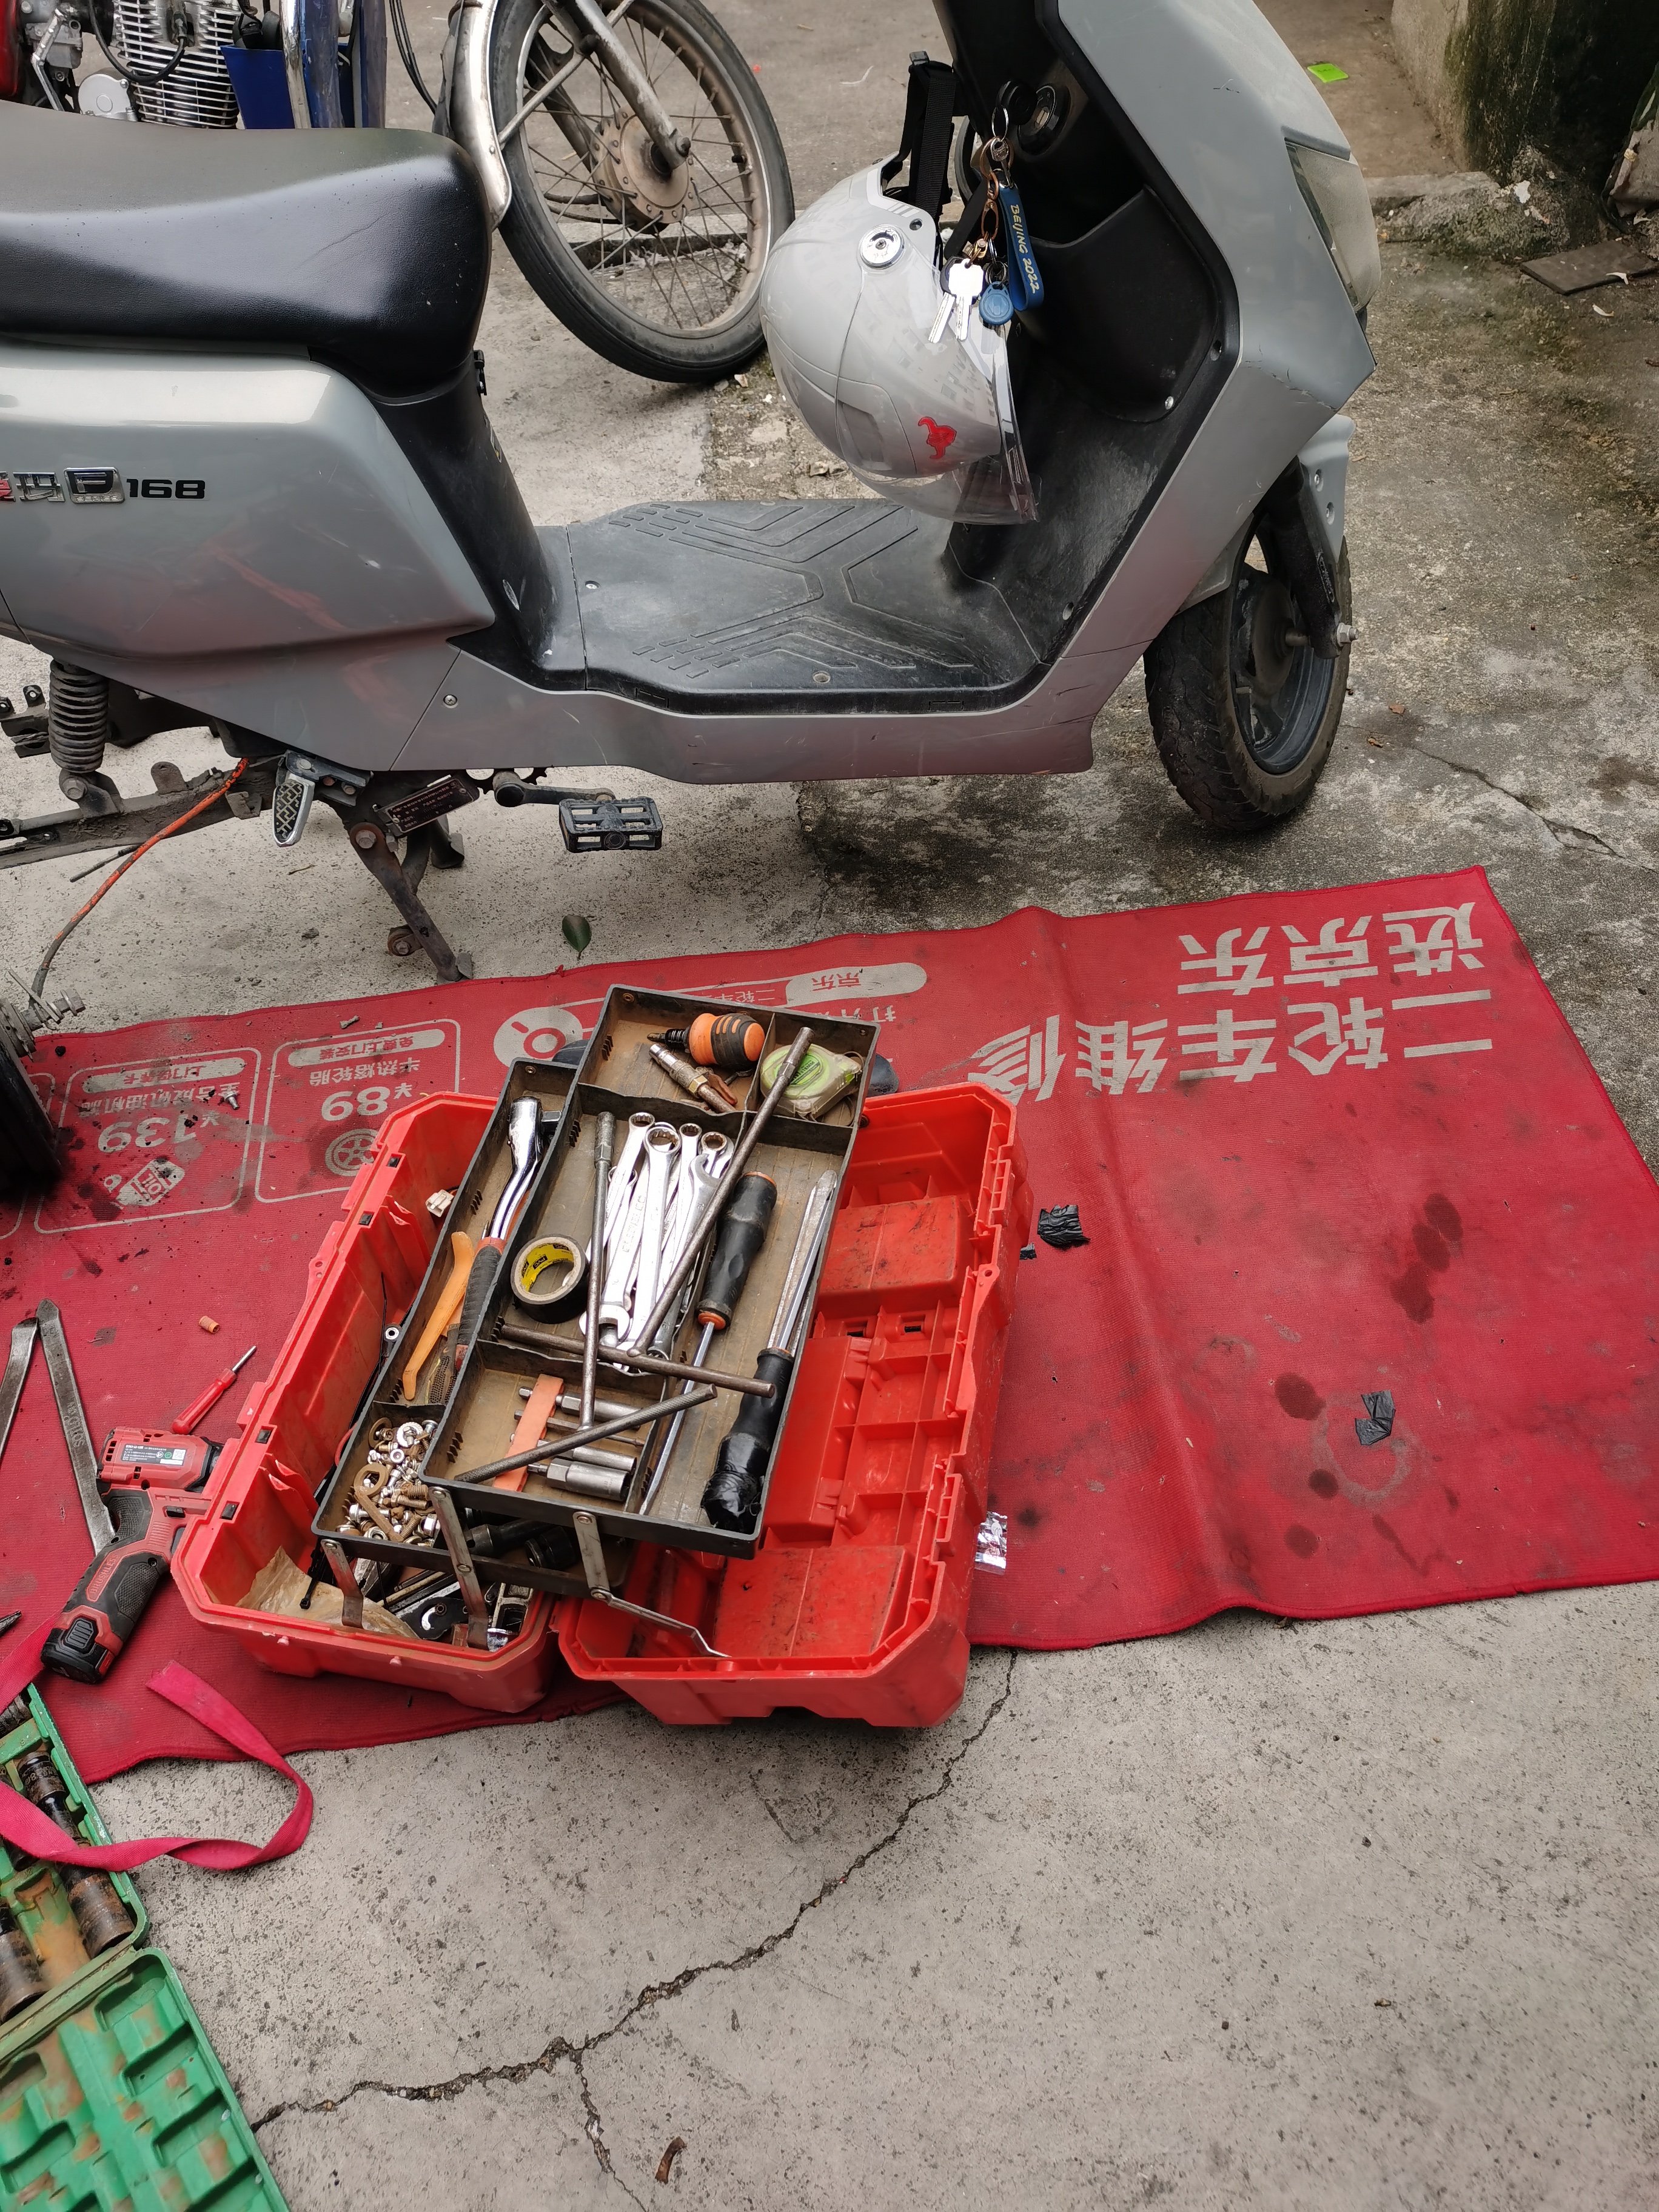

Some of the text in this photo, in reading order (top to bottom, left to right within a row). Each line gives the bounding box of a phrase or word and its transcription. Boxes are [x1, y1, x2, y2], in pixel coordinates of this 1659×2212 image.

[1010, 204, 1040, 294] BEIJING 2022
[126, 478, 206, 499] 168
[1178, 902, 1486, 996] 选京东
[812, 972, 862, 991] 京东
[317, 1033, 415, 1062] 免费上门安装
[967, 988, 1493, 1105] 二轮车维修
[123, 1065, 203, 1085] 上门保养卡
[309, 1056, 420, 1087] 半热熔轮胎
[140, 1171, 164, 1199] OIL
[533, 1256, 548, 1269] PVC
[89, 1553, 119, 1595] BRUSHLESS
